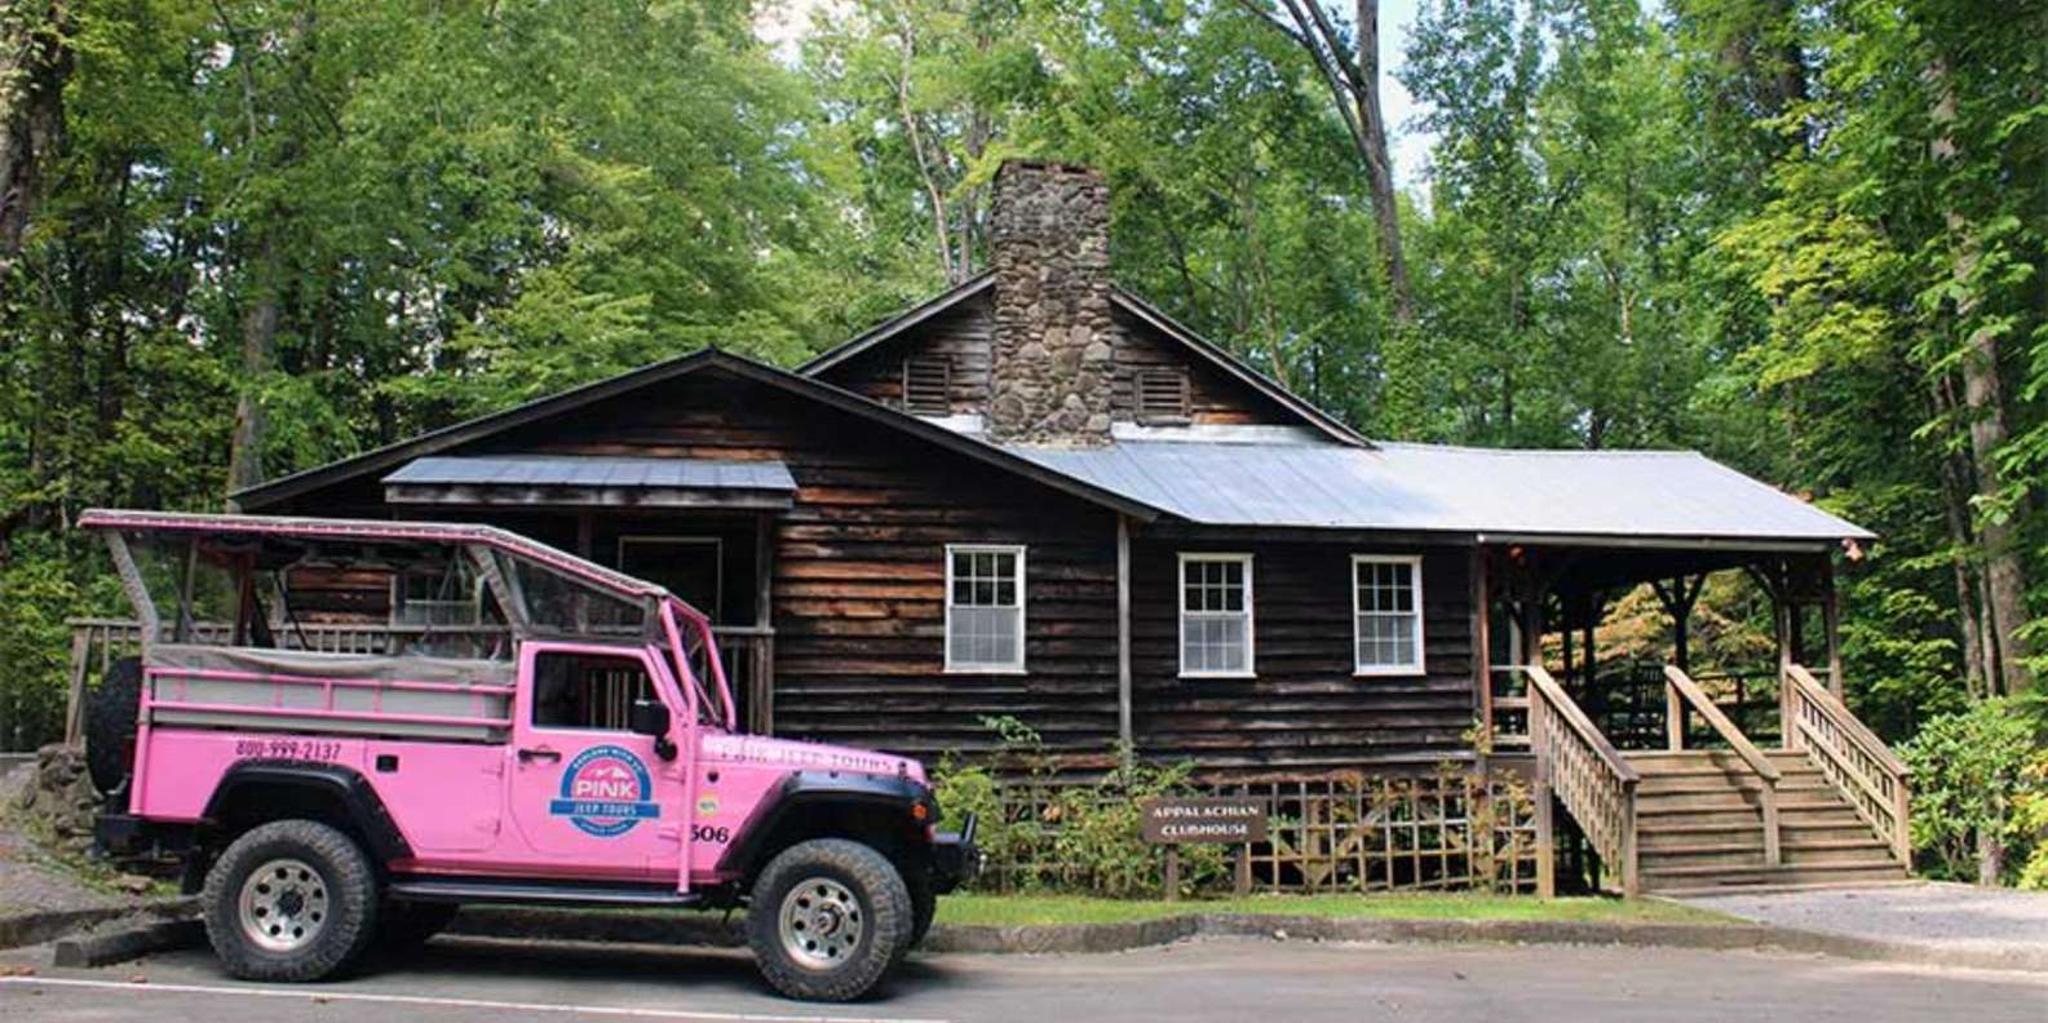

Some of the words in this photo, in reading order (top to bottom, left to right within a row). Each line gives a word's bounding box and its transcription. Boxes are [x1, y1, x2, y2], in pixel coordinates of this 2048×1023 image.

[235, 740, 342, 760] 800-999-2137
[576, 780, 635, 800] PINK
[1152, 805, 1259, 818] APPALACHIAN
[1160, 823, 1248, 836] CLUBHOUSE
